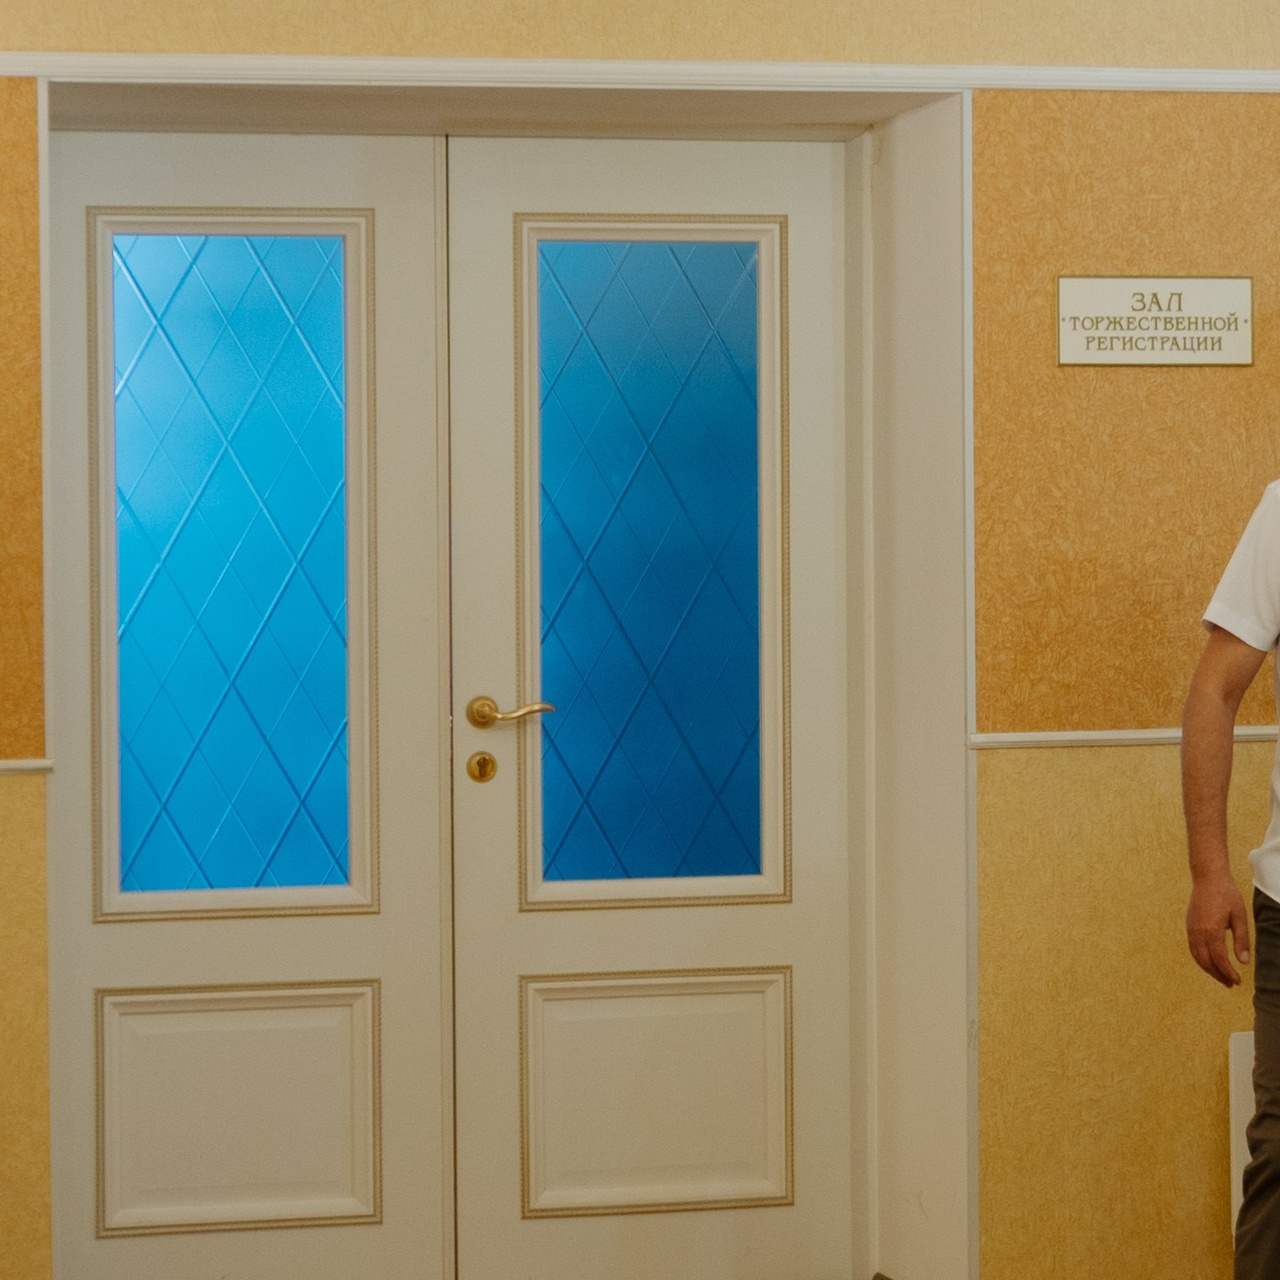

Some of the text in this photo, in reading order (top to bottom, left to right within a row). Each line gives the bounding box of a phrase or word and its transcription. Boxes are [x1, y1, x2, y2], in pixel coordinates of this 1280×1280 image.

[1131, 292, 1183, 312] ЗАЛ
[1069, 312, 1239, 331] ТОРЖЕСТВЕННОЙ
[1085, 336, 1223, 353] РЕГИСТРАЦИИ
